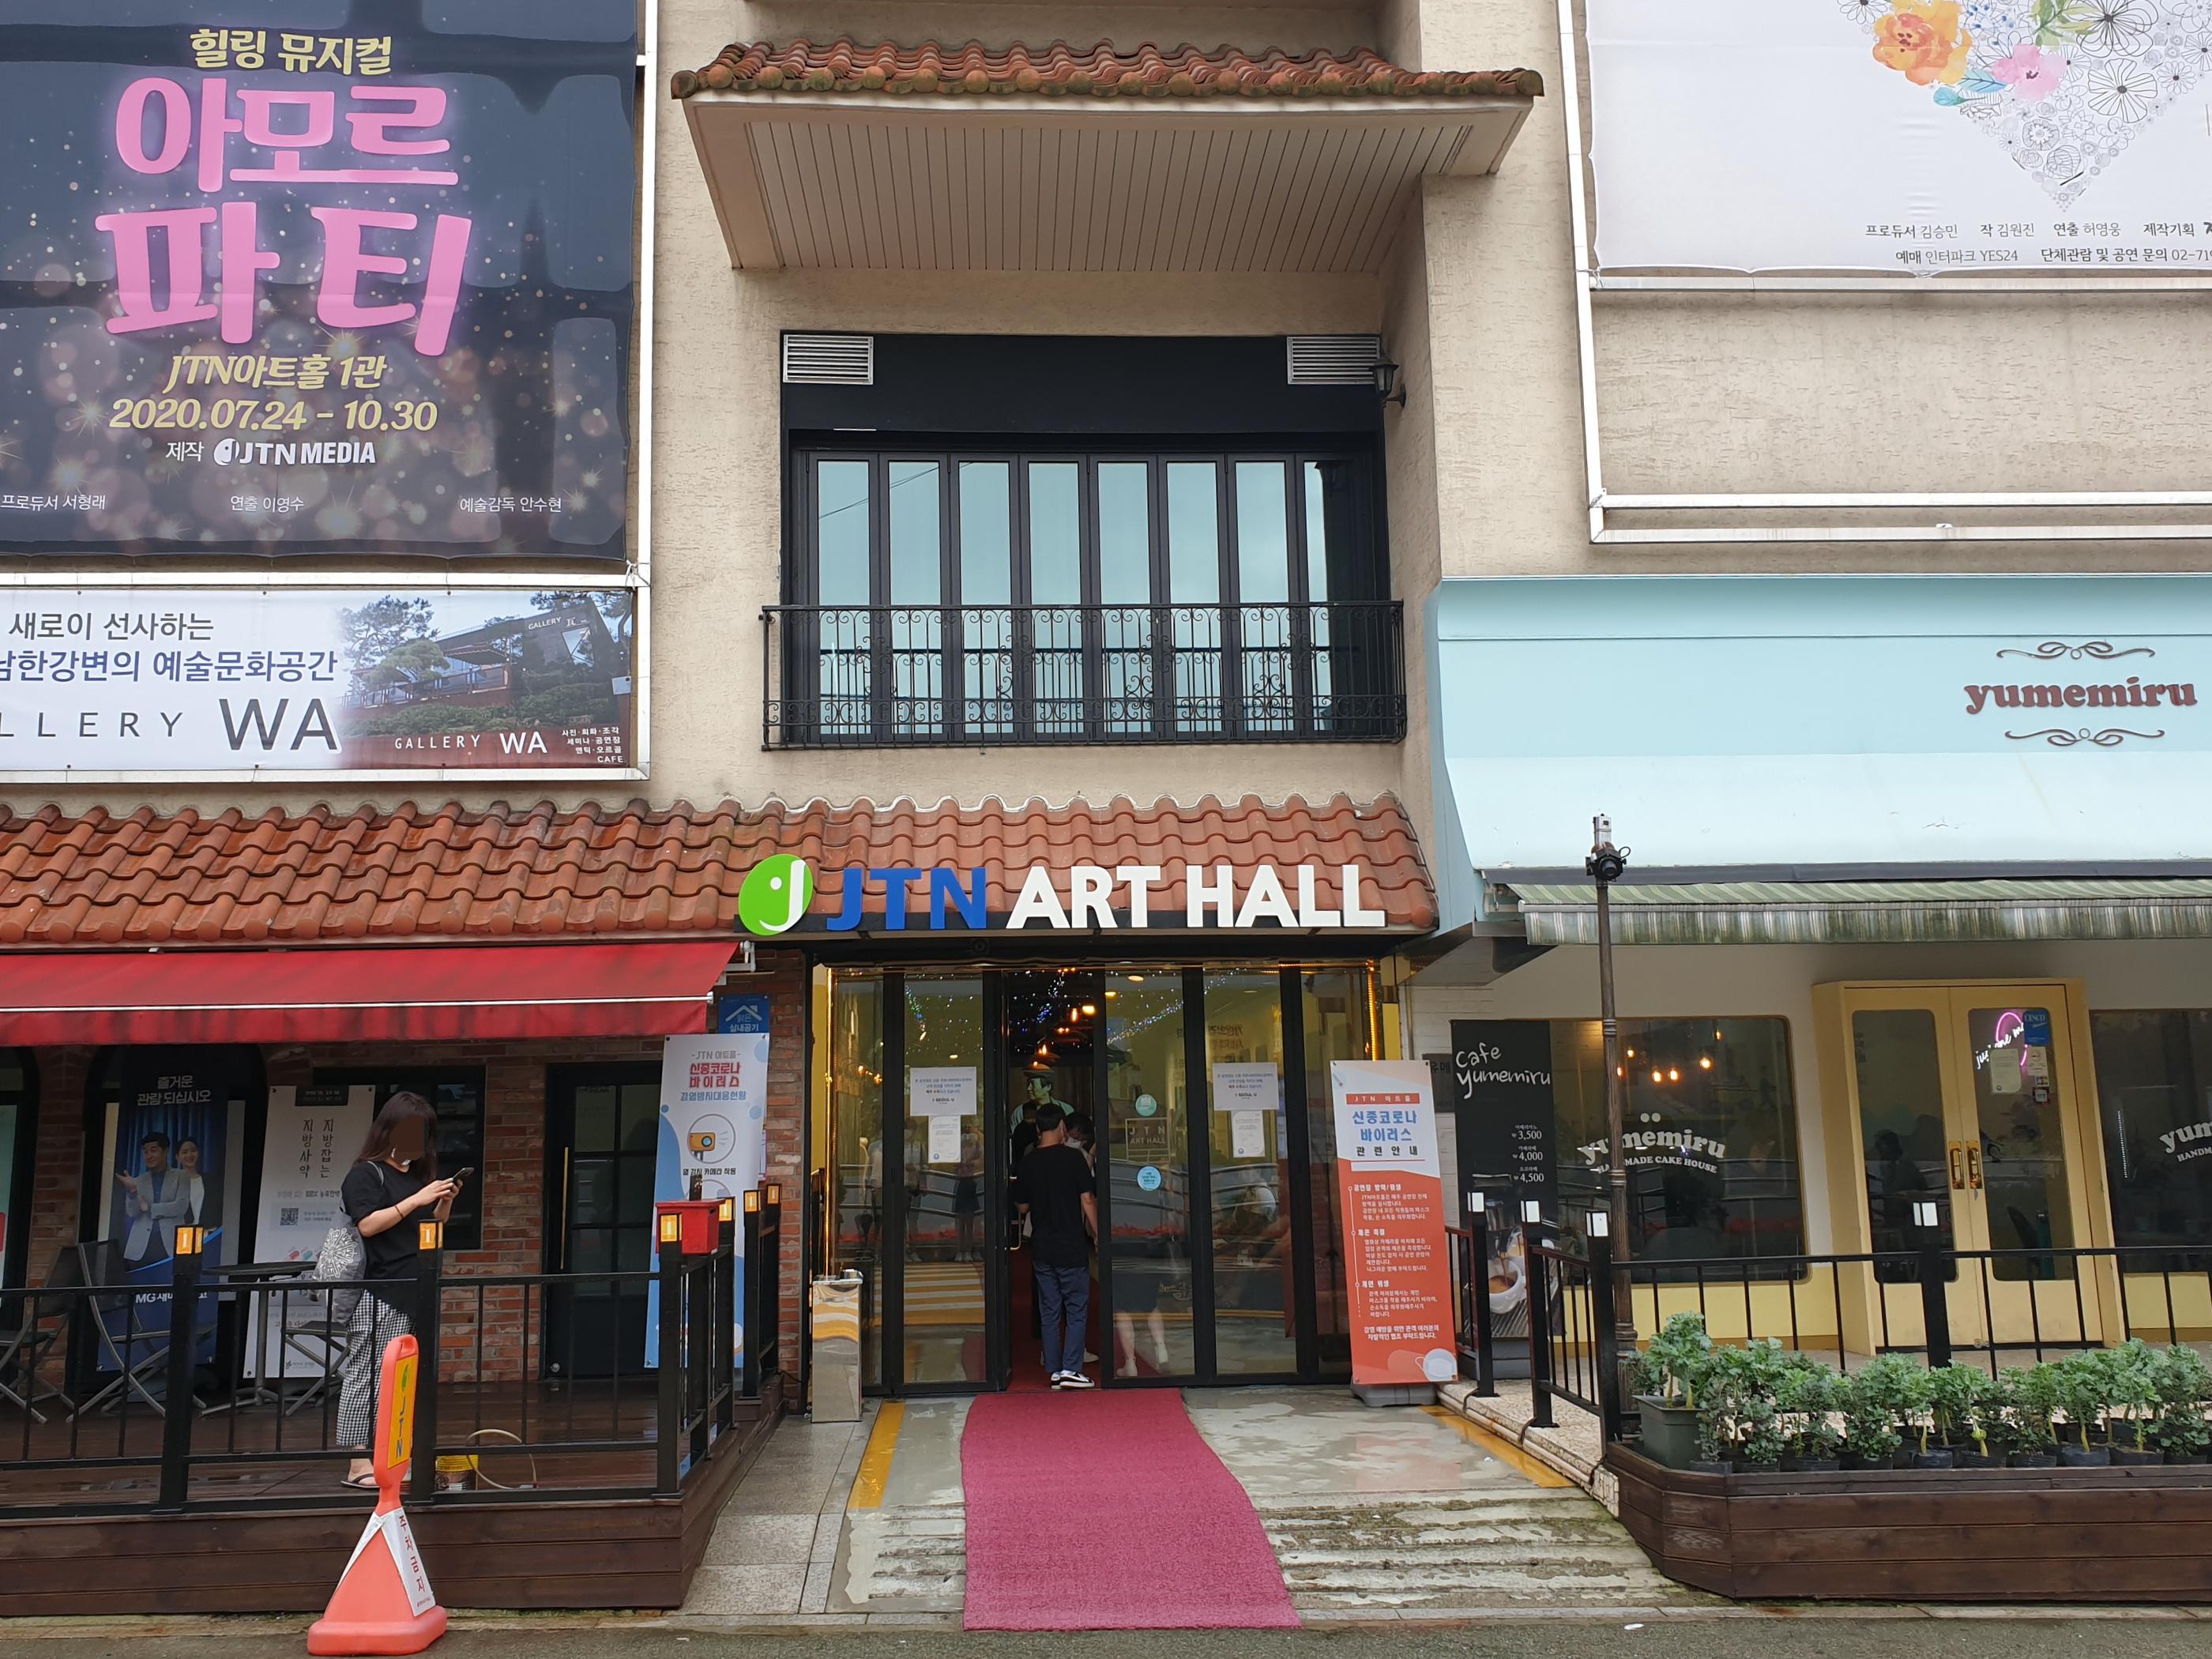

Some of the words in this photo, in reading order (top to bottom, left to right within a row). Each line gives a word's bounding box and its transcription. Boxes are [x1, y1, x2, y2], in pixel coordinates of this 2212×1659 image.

[190, 28, 267, 69] 힐링
[277, 33, 392, 76] 뮤지컬
[115, 77, 459, 193] 아모르
[1865, 224, 1916, 239] 프로듀서
[1920, 224, 1958, 239] 김승민
[1980, 224, 1994, 238] 작
[1997, 222, 2035, 237] 김원진
[2053, 222, 2079, 237] 연출
[2082, 222, 2121, 237] 허영웅
[2143, 222, 2195, 237] 제작기획
[1896, 250, 1921, 265] 예매
[1925, 250, 1977, 265] 인터파크
[1980, 250, 2018, 262] YES24
[2041, 248, 2093, 263] 단체관람
[2096, 249, 2109, 263] 및
[2112, 248, 2139, 262] 공연
[2142, 247, 2168, 262] 문의
[95, 201, 472, 356] 파티
[162, 354, 332, 393] JTN아트홀
[340, 355, 387, 388] 1관
[109, 397, 307, 430] 2020.07.24
[344, 400, 438, 431] 10.30
[165, 441, 204, 462] 제작
[300, 442, 376, 465] MEDIA
[0, 494, 58, 510] 프로듀서
[62, 493, 107, 510] 서형래
[230, 495, 258, 512] 연출
[262, 495, 304, 513] 이영수
[460, 496, 516, 513] 예술감독
[520, 495, 562, 514] 안수현
[9, 611, 92, 641] 새로이
[103, 611, 214, 641] 선사하는
[528, 616, 562, 630] GALLERY
[153, 649, 337, 683] 예술문화공간
[1964, 675, 2198, 715] yumemiru
[219, 698, 338, 751] WA
[394, 734, 480, 750] GALLERY
[499, 732, 548, 754] WA
[826, 866, 988, 931] JTN
[1006, 864, 1161, 930] ART
[1187, 864, 1387, 929] HALL
[1455, 1041, 1502, 1069] Cafe
[690, 1062, 741, 1075] 신종코로나
[1455, 1069, 1551, 1100] yumemiru
[1352, 1110, 1417, 1124] 신종코로나
[1360, 1127, 1413, 1142] 바이러스
[1654, 1156, 1683, 1166] CAKE
[1683, 1157, 1718, 1174] HOUSE
